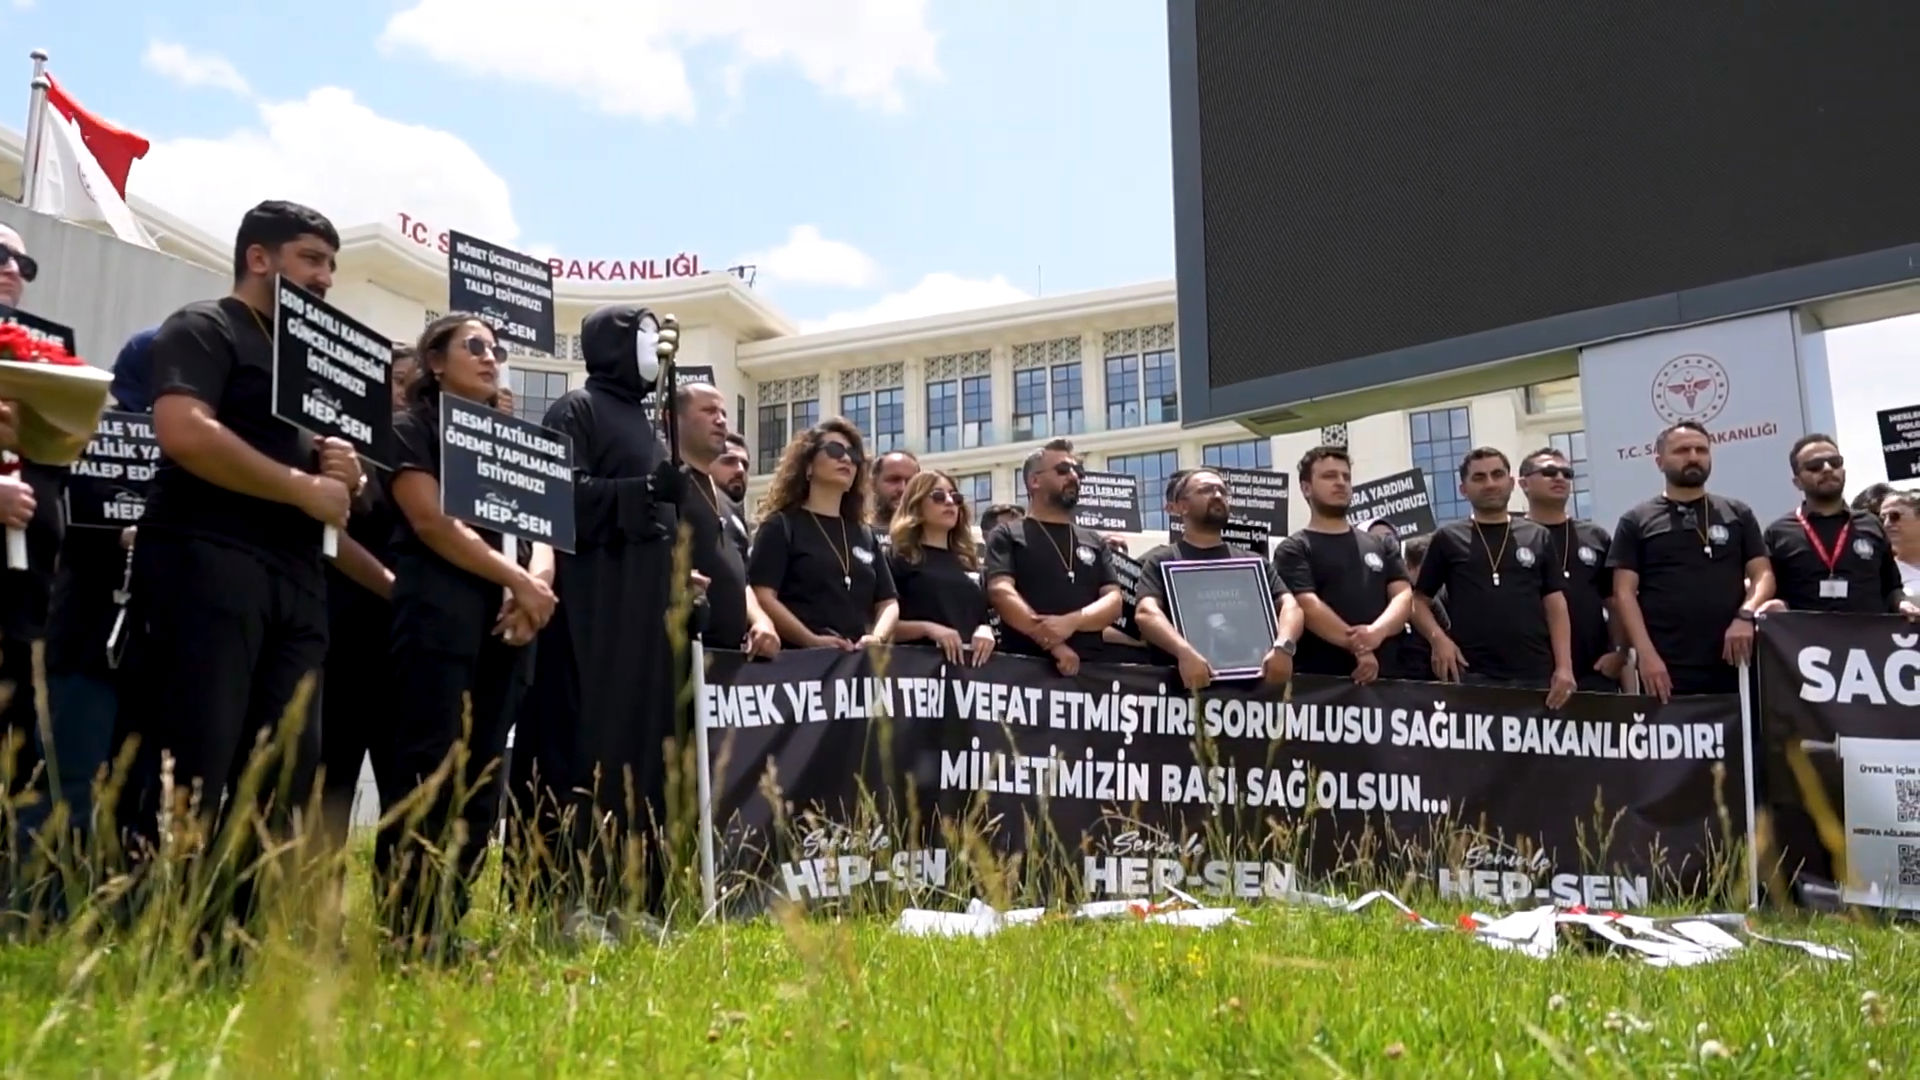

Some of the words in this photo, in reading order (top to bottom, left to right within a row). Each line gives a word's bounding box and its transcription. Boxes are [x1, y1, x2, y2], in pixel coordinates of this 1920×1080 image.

[398, 212, 432, 248] T.C.
[438, 233, 450, 254] S
[548, 253, 699, 280] BAKANLIĞI
[452, 259, 459, 270] 3
[460, 260, 492, 281] KATINA
[464, 278, 495, 296] TALEP
[495, 288, 542, 312] EDİYORUZ!
[305, 303, 340, 336] SAYILI
[302, 394, 372, 444] HEP-SEN
[452, 408, 493, 434] RESMİ
[494, 425, 566, 459] TATİLLERDE
[446, 425, 493, 456] ÖDEME
[495, 445, 572, 482] YAPILMASINI
[1616, 448, 1641, 460] T.C.
[1708, 422, 1778, 445] AKANLIĞI
[70, 460, 124, 478] TALEP
[477, 456, 545, 495] İSTİYORUZ!
[1369, 477, 1414, 500] YARDIMI
[103, 501, 145, 520] HEP
[475, 499, 552, 537] HEP-SEN
[1075, 515, 1126, 528] HEP-SEN
[1371, 492, 1428, 518] EDİYORUZ!
[1797, 633, 1920, 706] SAĞ
[705, 680, 784, 728] EMEK
[783, 680, 827, 723] VE
[834, 675, 895, 720] ALIN
[898, 664, 946, 720] TERİ
[952, 678, 1043, 726] VEFAT
[1049, 680, 1196, 744] ETMİŞTİR!
[1205, 698, 1383, 744] SORUMLUSU
[1391, 701, 1495, 752] SAĞLIK
[1502, 712, 1725, 760] BAKANLIĞIDIR!
[941, 736, 1149, 800] MİLLETİMİZİN
[1247, 759, 1305, 808] SAĞ
[1317, 770, 1448, 814] OLSUN...
[781, 848, 947, 901] HEP-SEN
[1084, 856, 1298, 898] HEP-SEN
[1438, 868, 1649, 910] HEP-SEN
